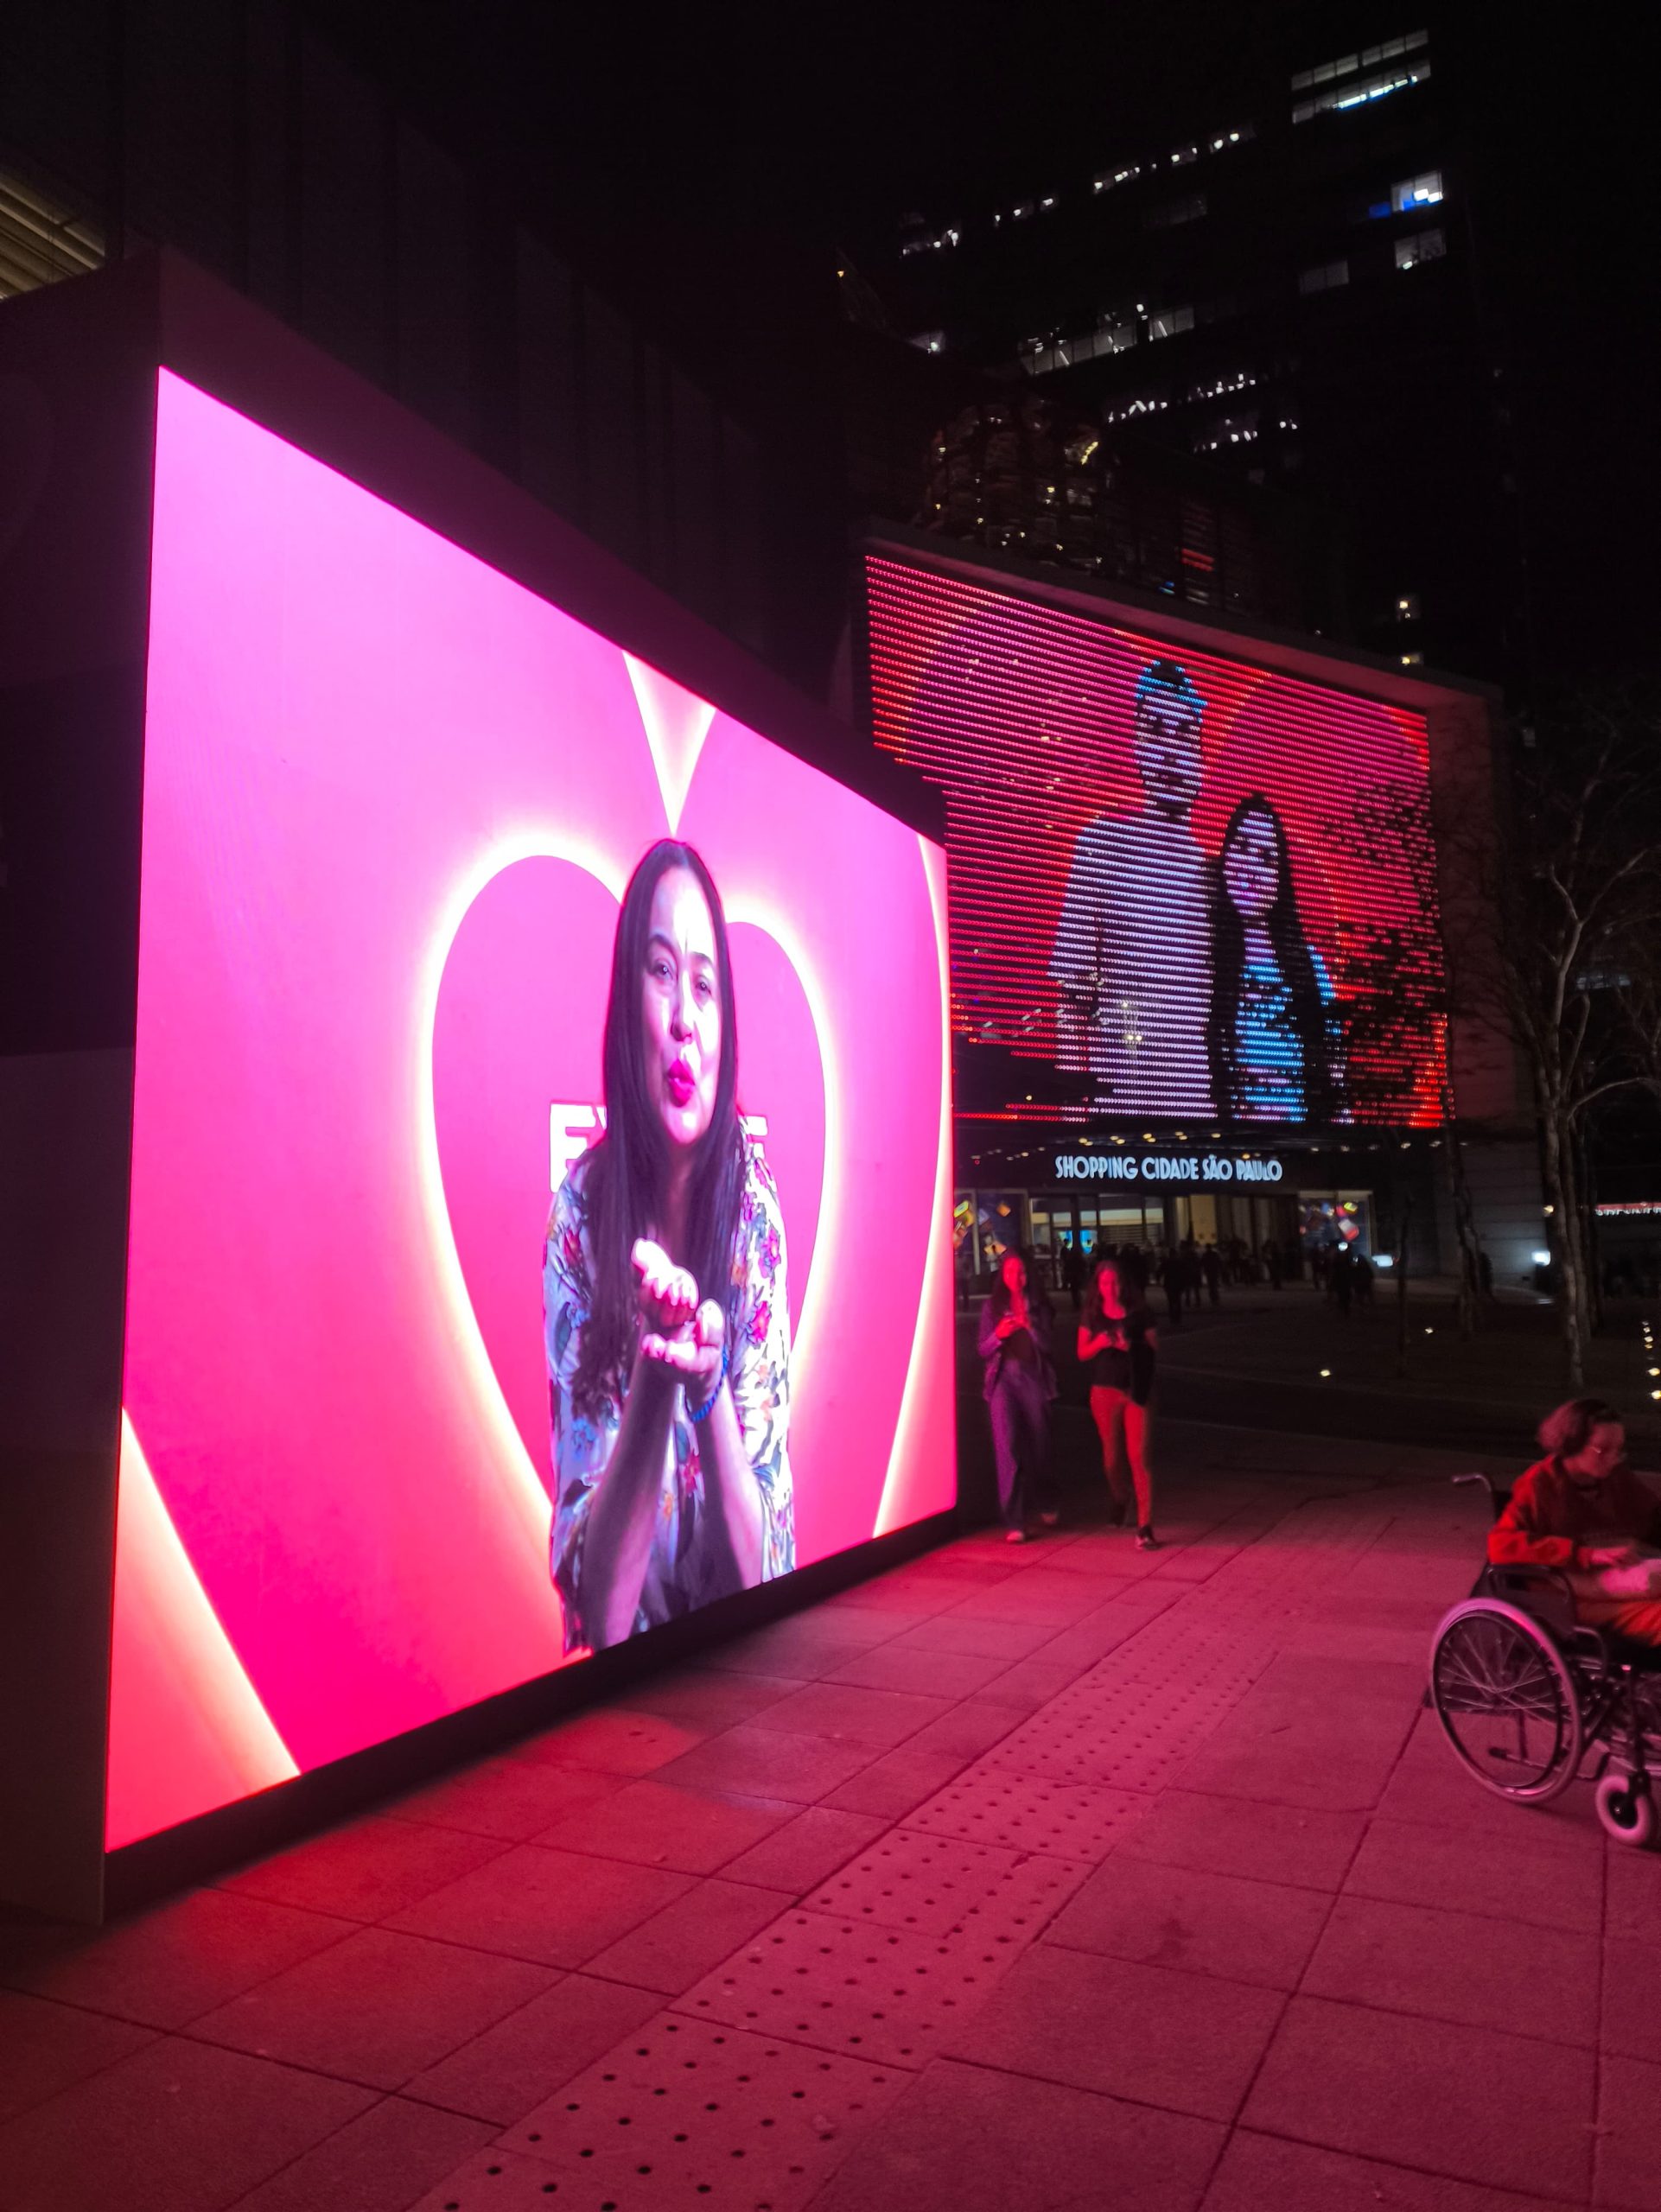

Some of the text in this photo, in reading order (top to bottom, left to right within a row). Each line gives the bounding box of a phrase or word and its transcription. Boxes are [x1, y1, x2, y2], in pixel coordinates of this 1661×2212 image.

[1055, 1154, 1282, 1181] SHOPPING CIDADE SÃO PAULO
